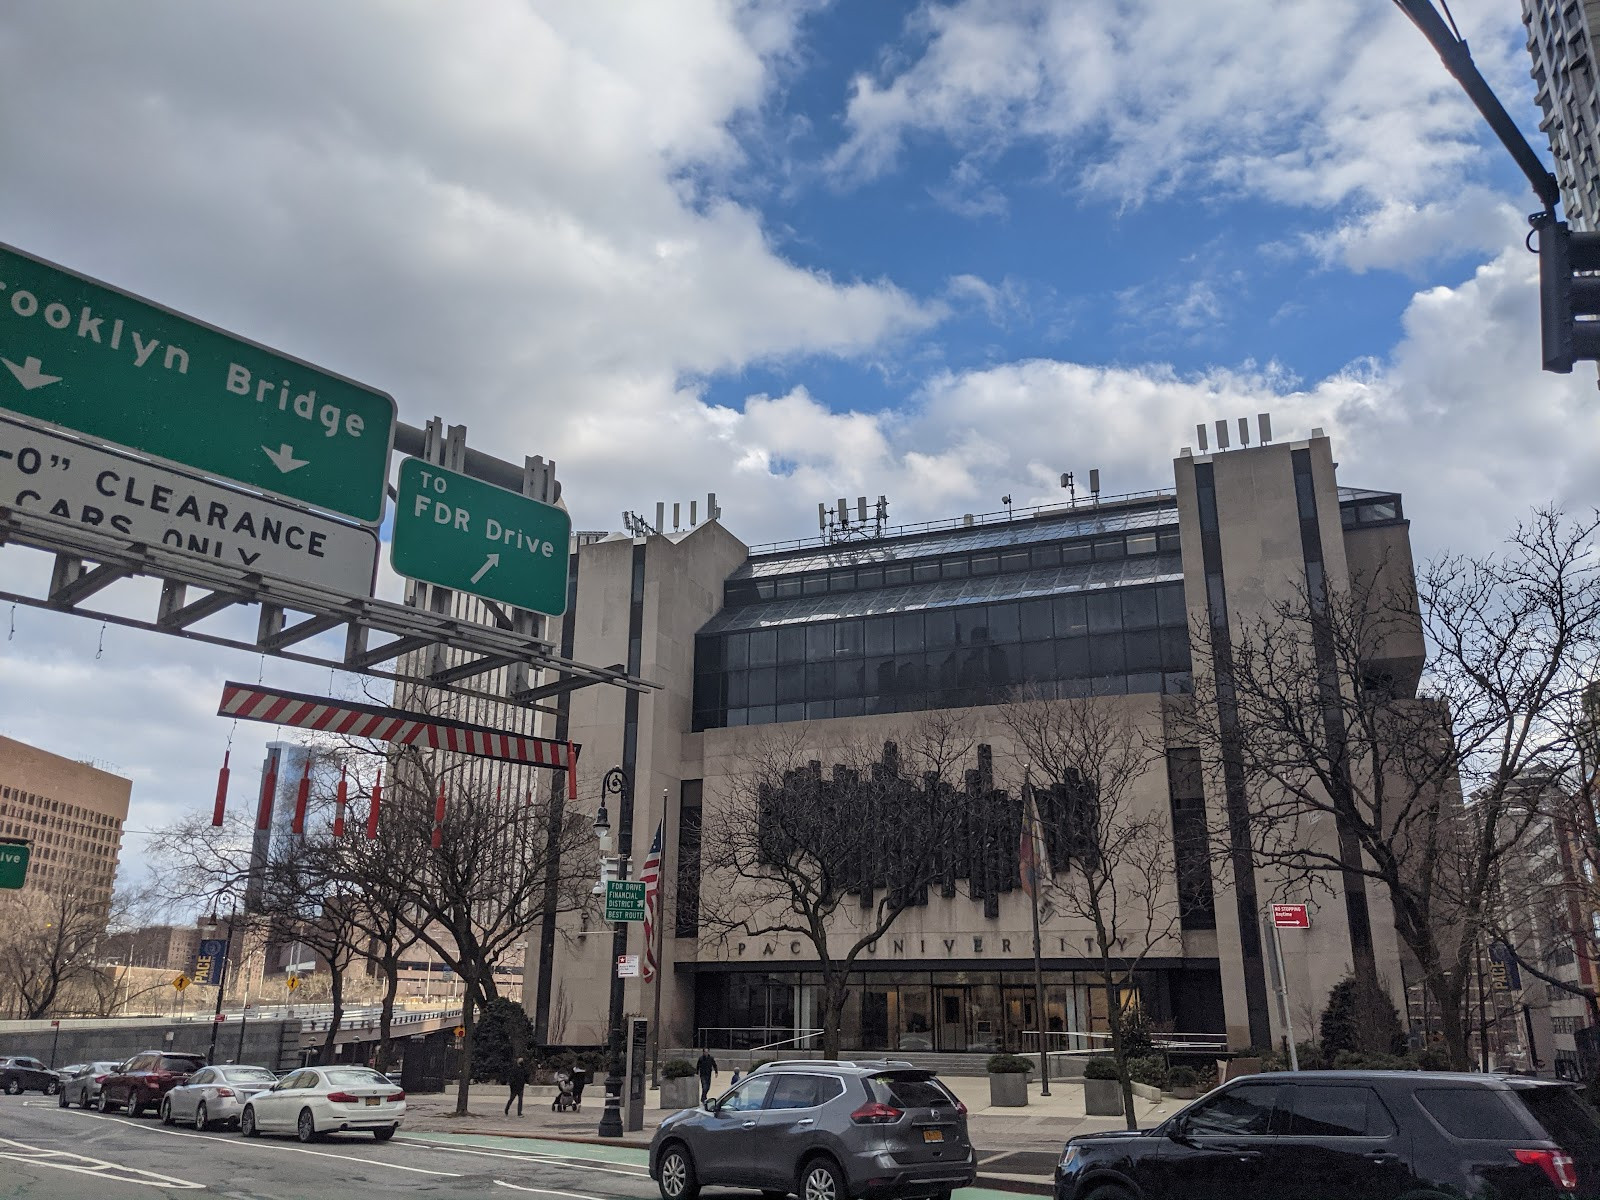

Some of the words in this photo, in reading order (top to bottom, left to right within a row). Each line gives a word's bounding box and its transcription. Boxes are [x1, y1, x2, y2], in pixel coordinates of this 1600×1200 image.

[0, 281, 190, 374] ooklyn
[226, 362, 365, 437] Bridge
[420, 471, 447, 494] TO
[96, 470, 327, 557] CLEARANCE
[414, 494, 471, 532] FDR
[486, 519, 554, 557] Drive
[608, 891, 639, 899] FINANCIAL
[611, 882, 624, 890] FDR
[625, 883, 642, 891] DRIVE
[608, 900, 634, 908] DISTRICT
[624, 911, 643, 919] ROUTE
[738, 941, 802, 955] PAC
[867, 936, 1128, 954] UNIVERITY
[194, 955, 211, 983] PACE
[1491, 960, 1508, 990] PACE
